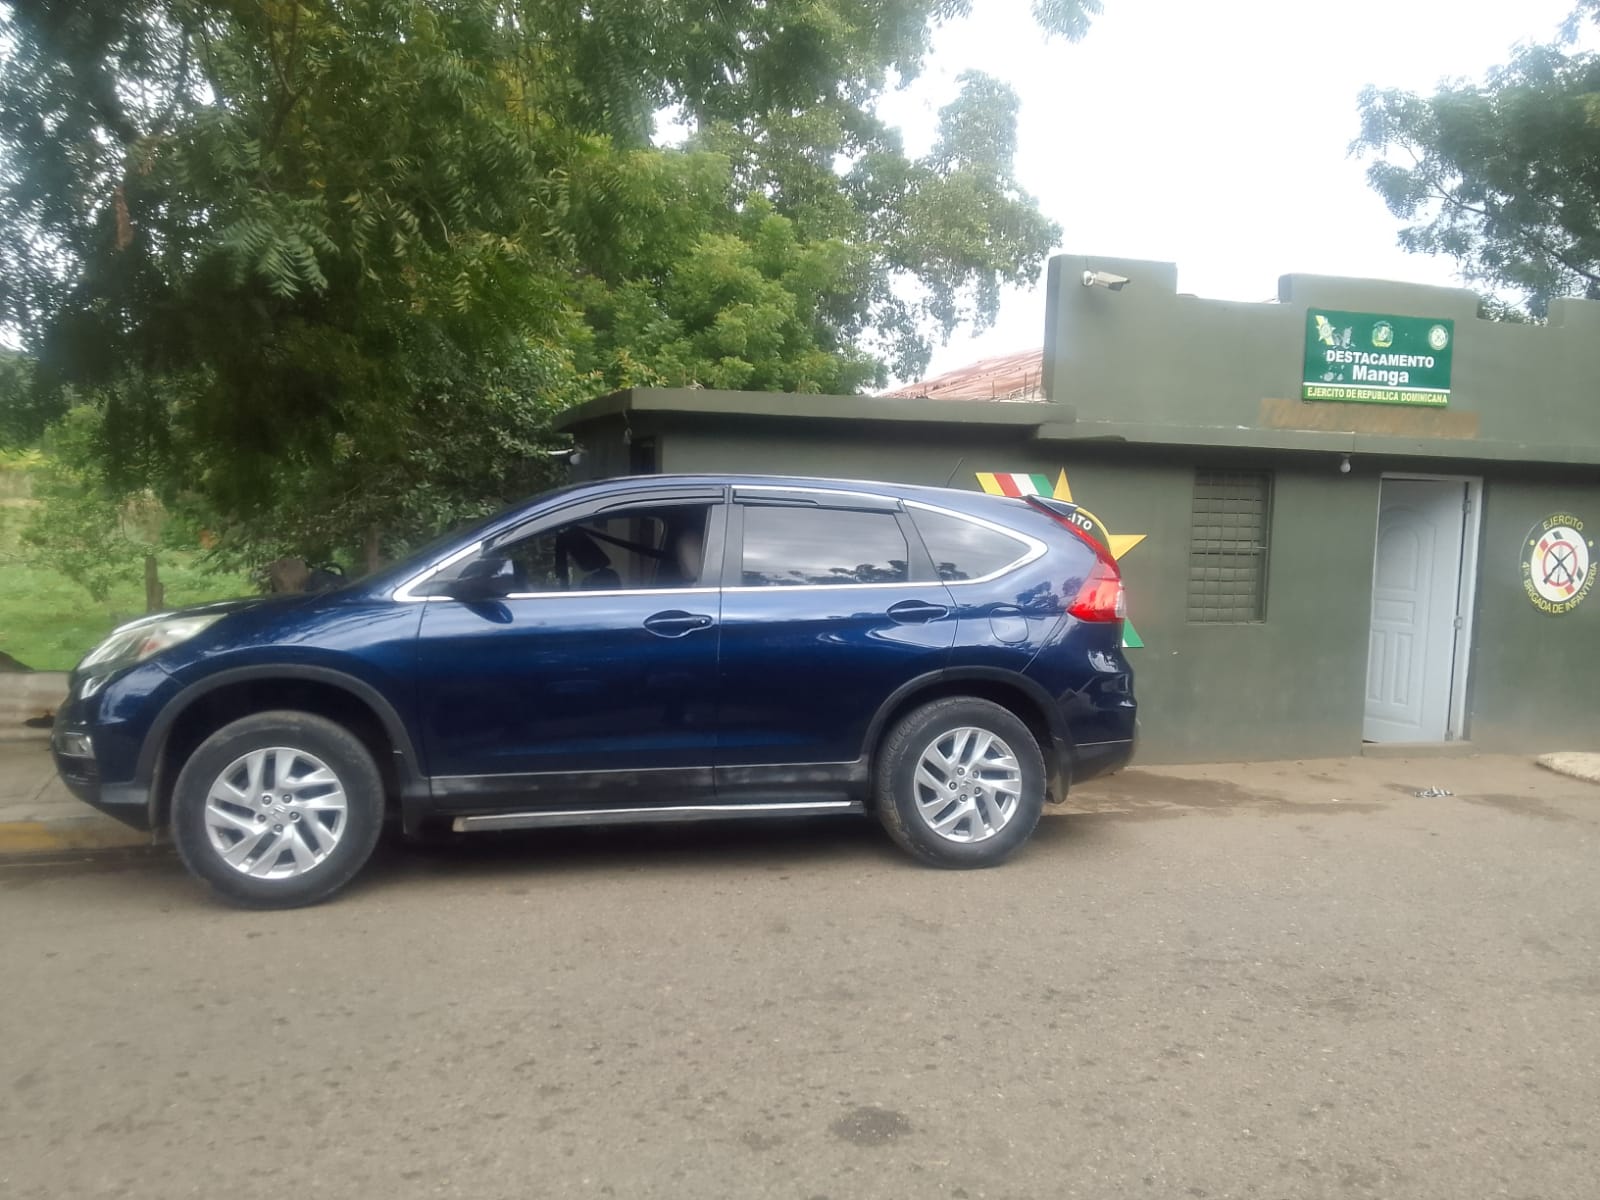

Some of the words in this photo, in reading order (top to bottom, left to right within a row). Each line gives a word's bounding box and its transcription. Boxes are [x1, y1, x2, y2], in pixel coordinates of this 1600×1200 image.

[1326, 350, 1434, 368] DESTACAMENTO
[1352, 365, 1409, 385] Manga
[1307, 389, 1345, 398] EJERCITO
[1346, 390, 1356, 399] DE
[1357, 390, 1399, 401] REPUBLICA
[1401, 393, 1448, 403] DOMINICANA
[1542, 515, 1583, 530] EJERCITO
[1524, 578, 1551, 613] BRIGADA
[1552, 604, 1564, 613] DE
[1565, 561, 1598, 612] INFANTERIA
